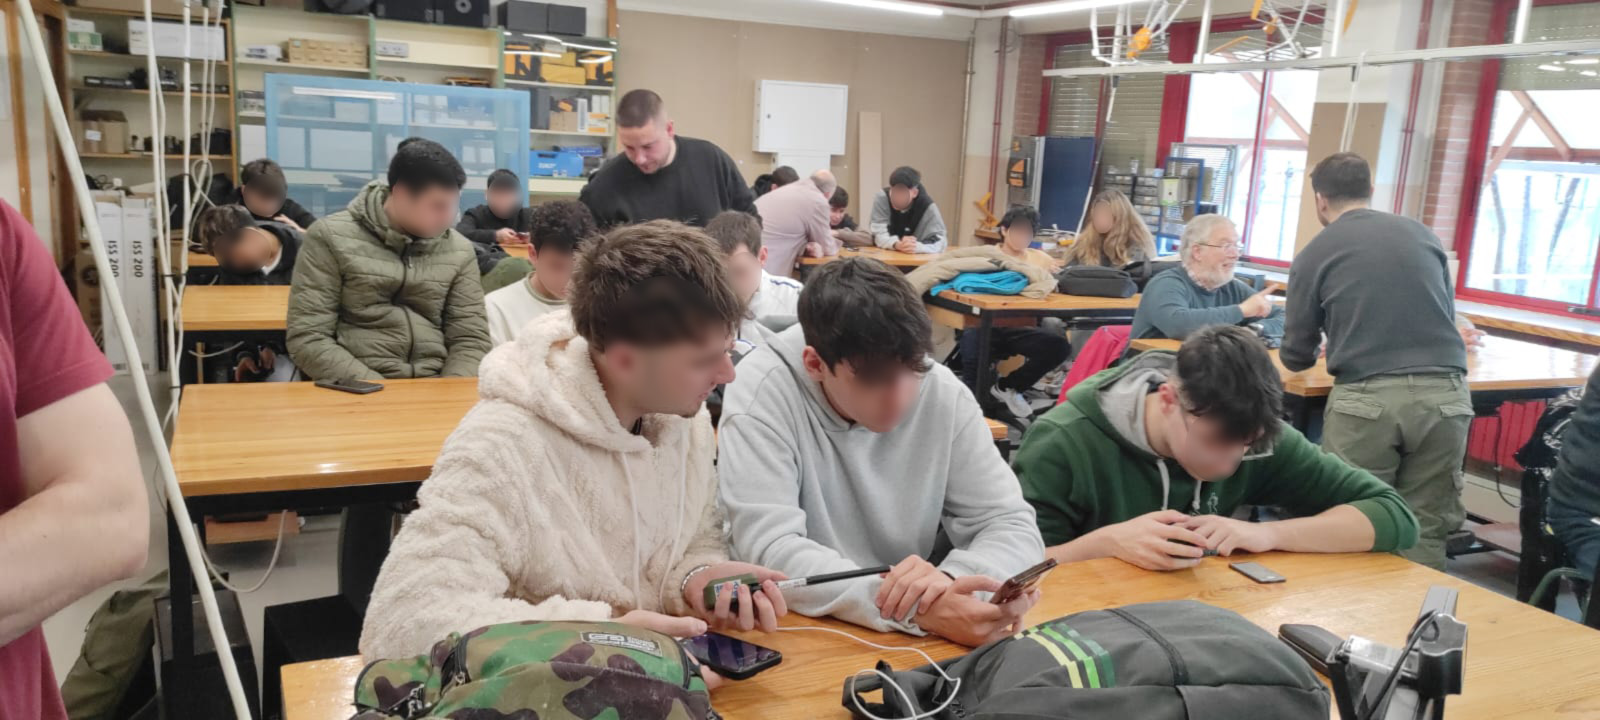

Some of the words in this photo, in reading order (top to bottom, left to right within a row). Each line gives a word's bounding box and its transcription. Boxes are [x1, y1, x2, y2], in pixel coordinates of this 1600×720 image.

[108, 240, 118, 255] ISS
[132, 240, 143, 255] ISS
[133, 258, 144, 278] 200
